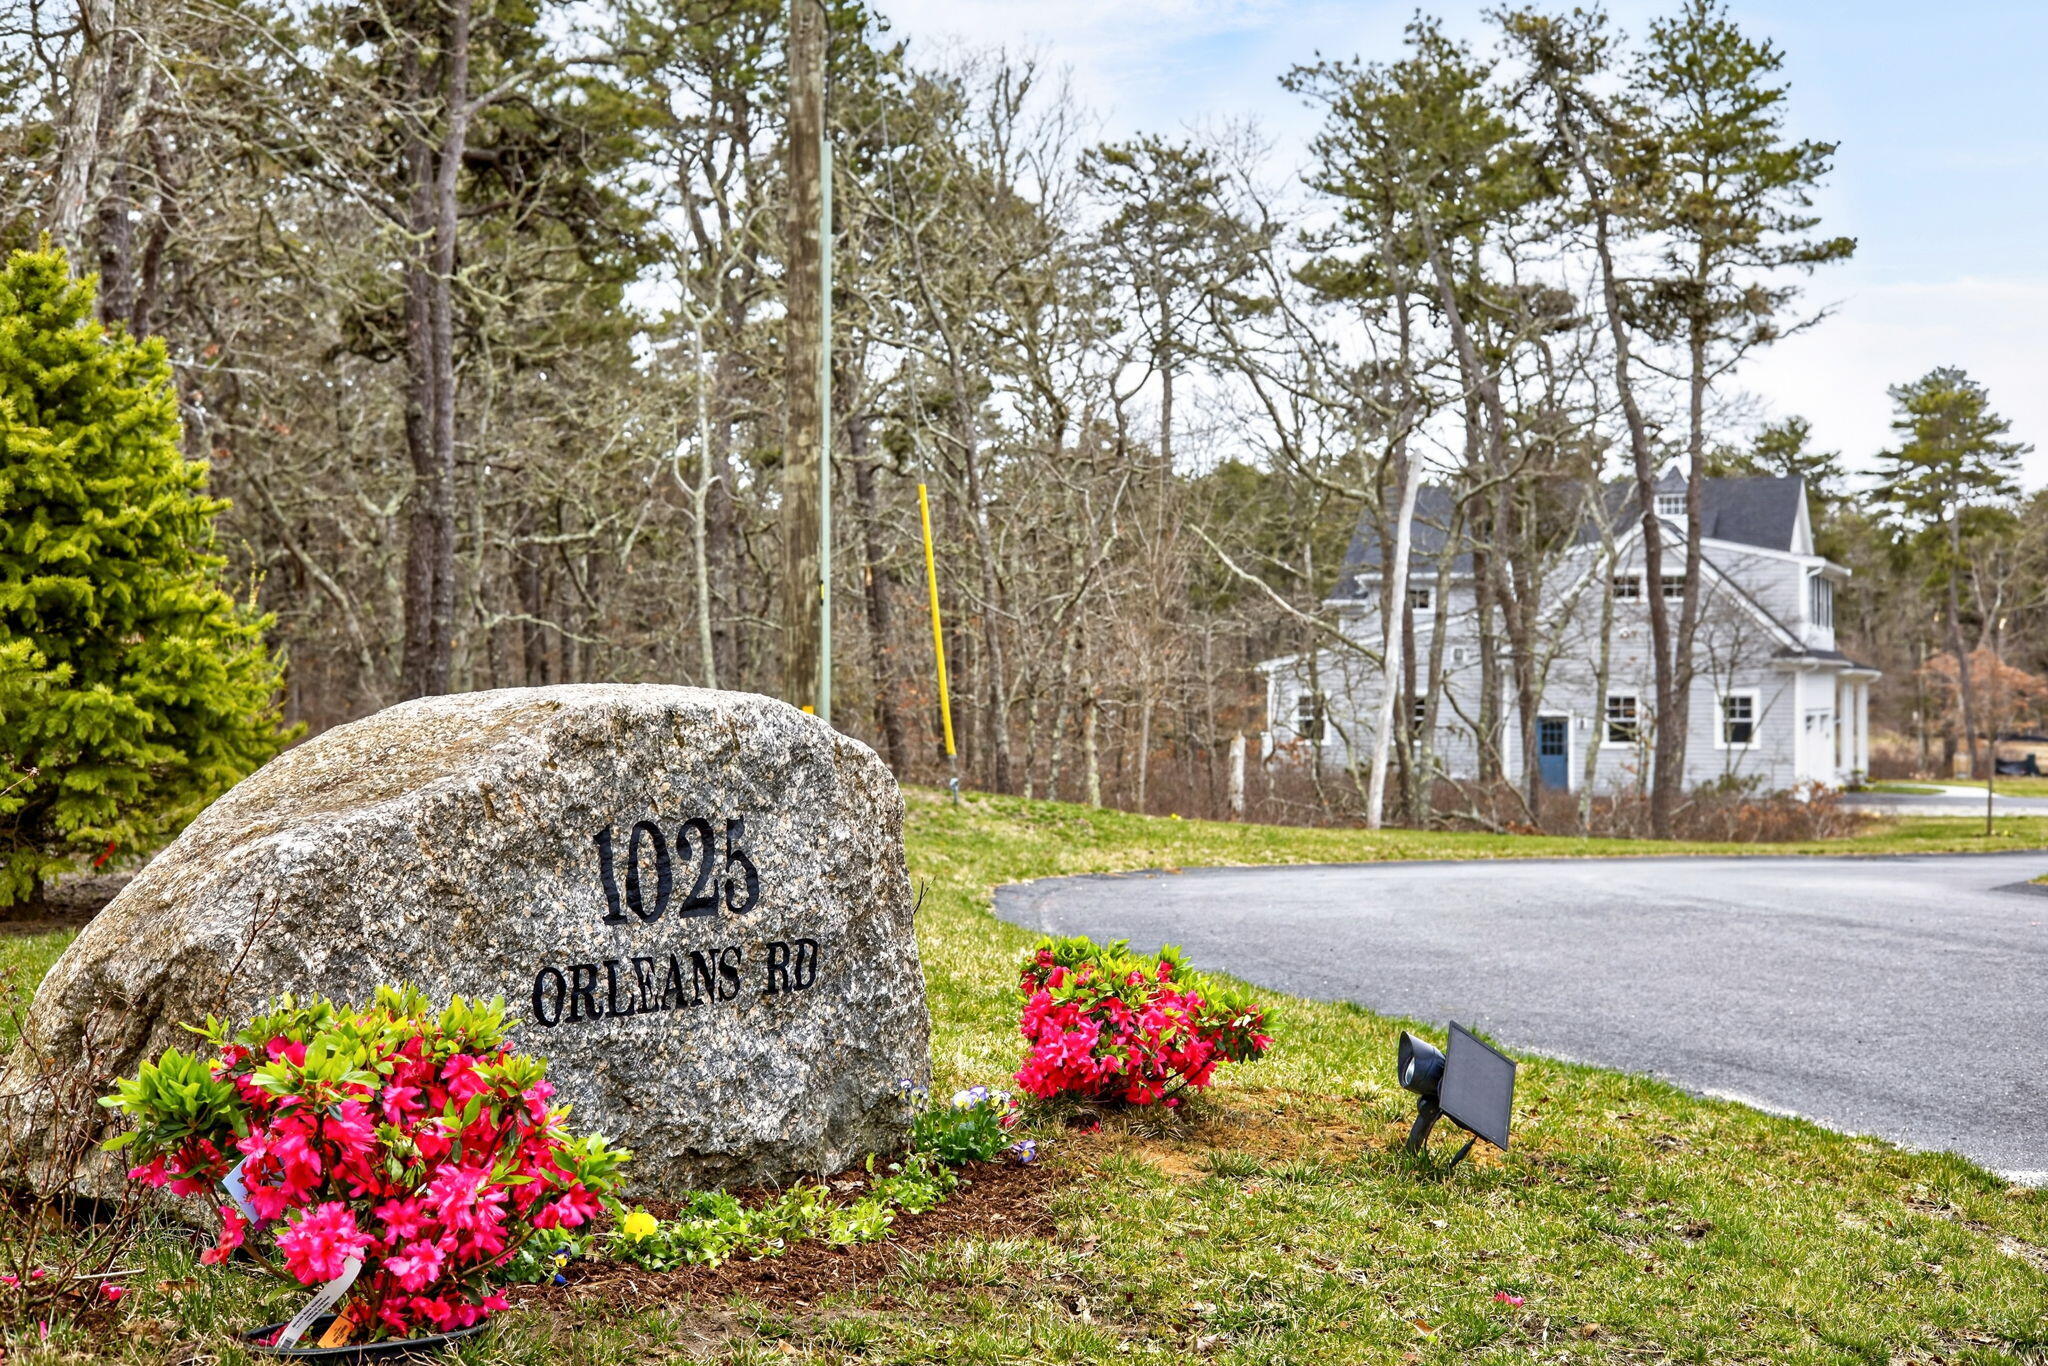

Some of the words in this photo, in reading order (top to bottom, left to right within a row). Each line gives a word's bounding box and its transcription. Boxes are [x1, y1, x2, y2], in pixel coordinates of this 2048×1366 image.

[593, 817, 759, 925] 1025
[532, 946, 742, 1028] ORLEANS
[763, 938, 818, 995] RD
